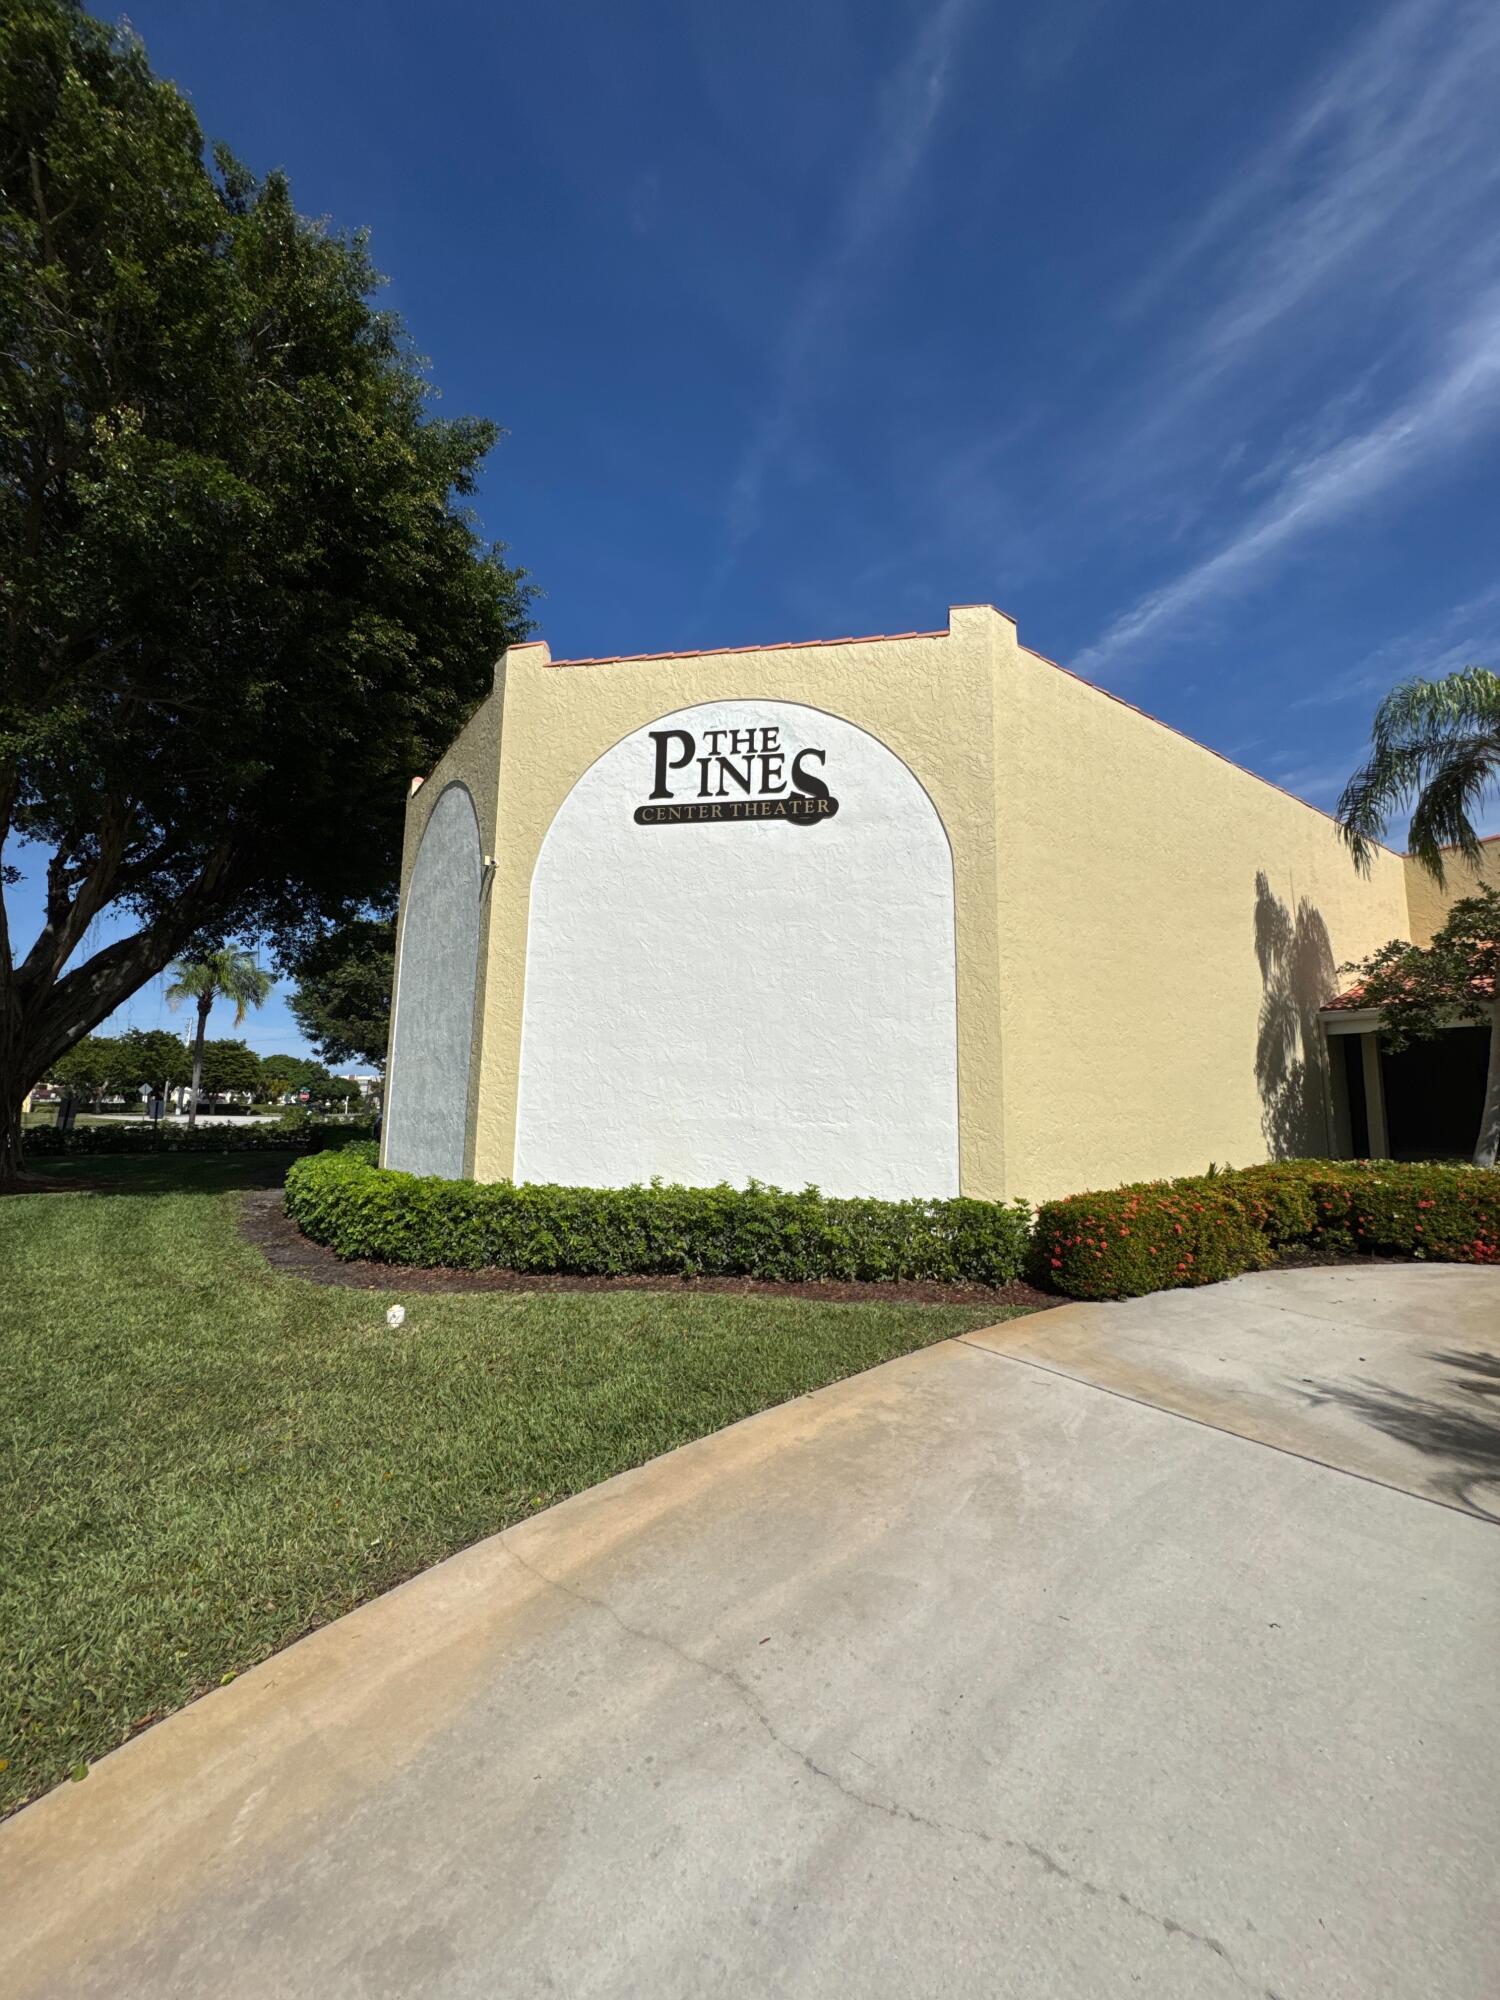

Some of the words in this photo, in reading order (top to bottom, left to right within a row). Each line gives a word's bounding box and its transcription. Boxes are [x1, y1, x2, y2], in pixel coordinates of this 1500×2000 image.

[703, 726, 781, 756] THE
[648, 729, 831, 806] PINES
[641, 805, 723, 821] CENTER
[730, 799, 831, 817] THEATER
